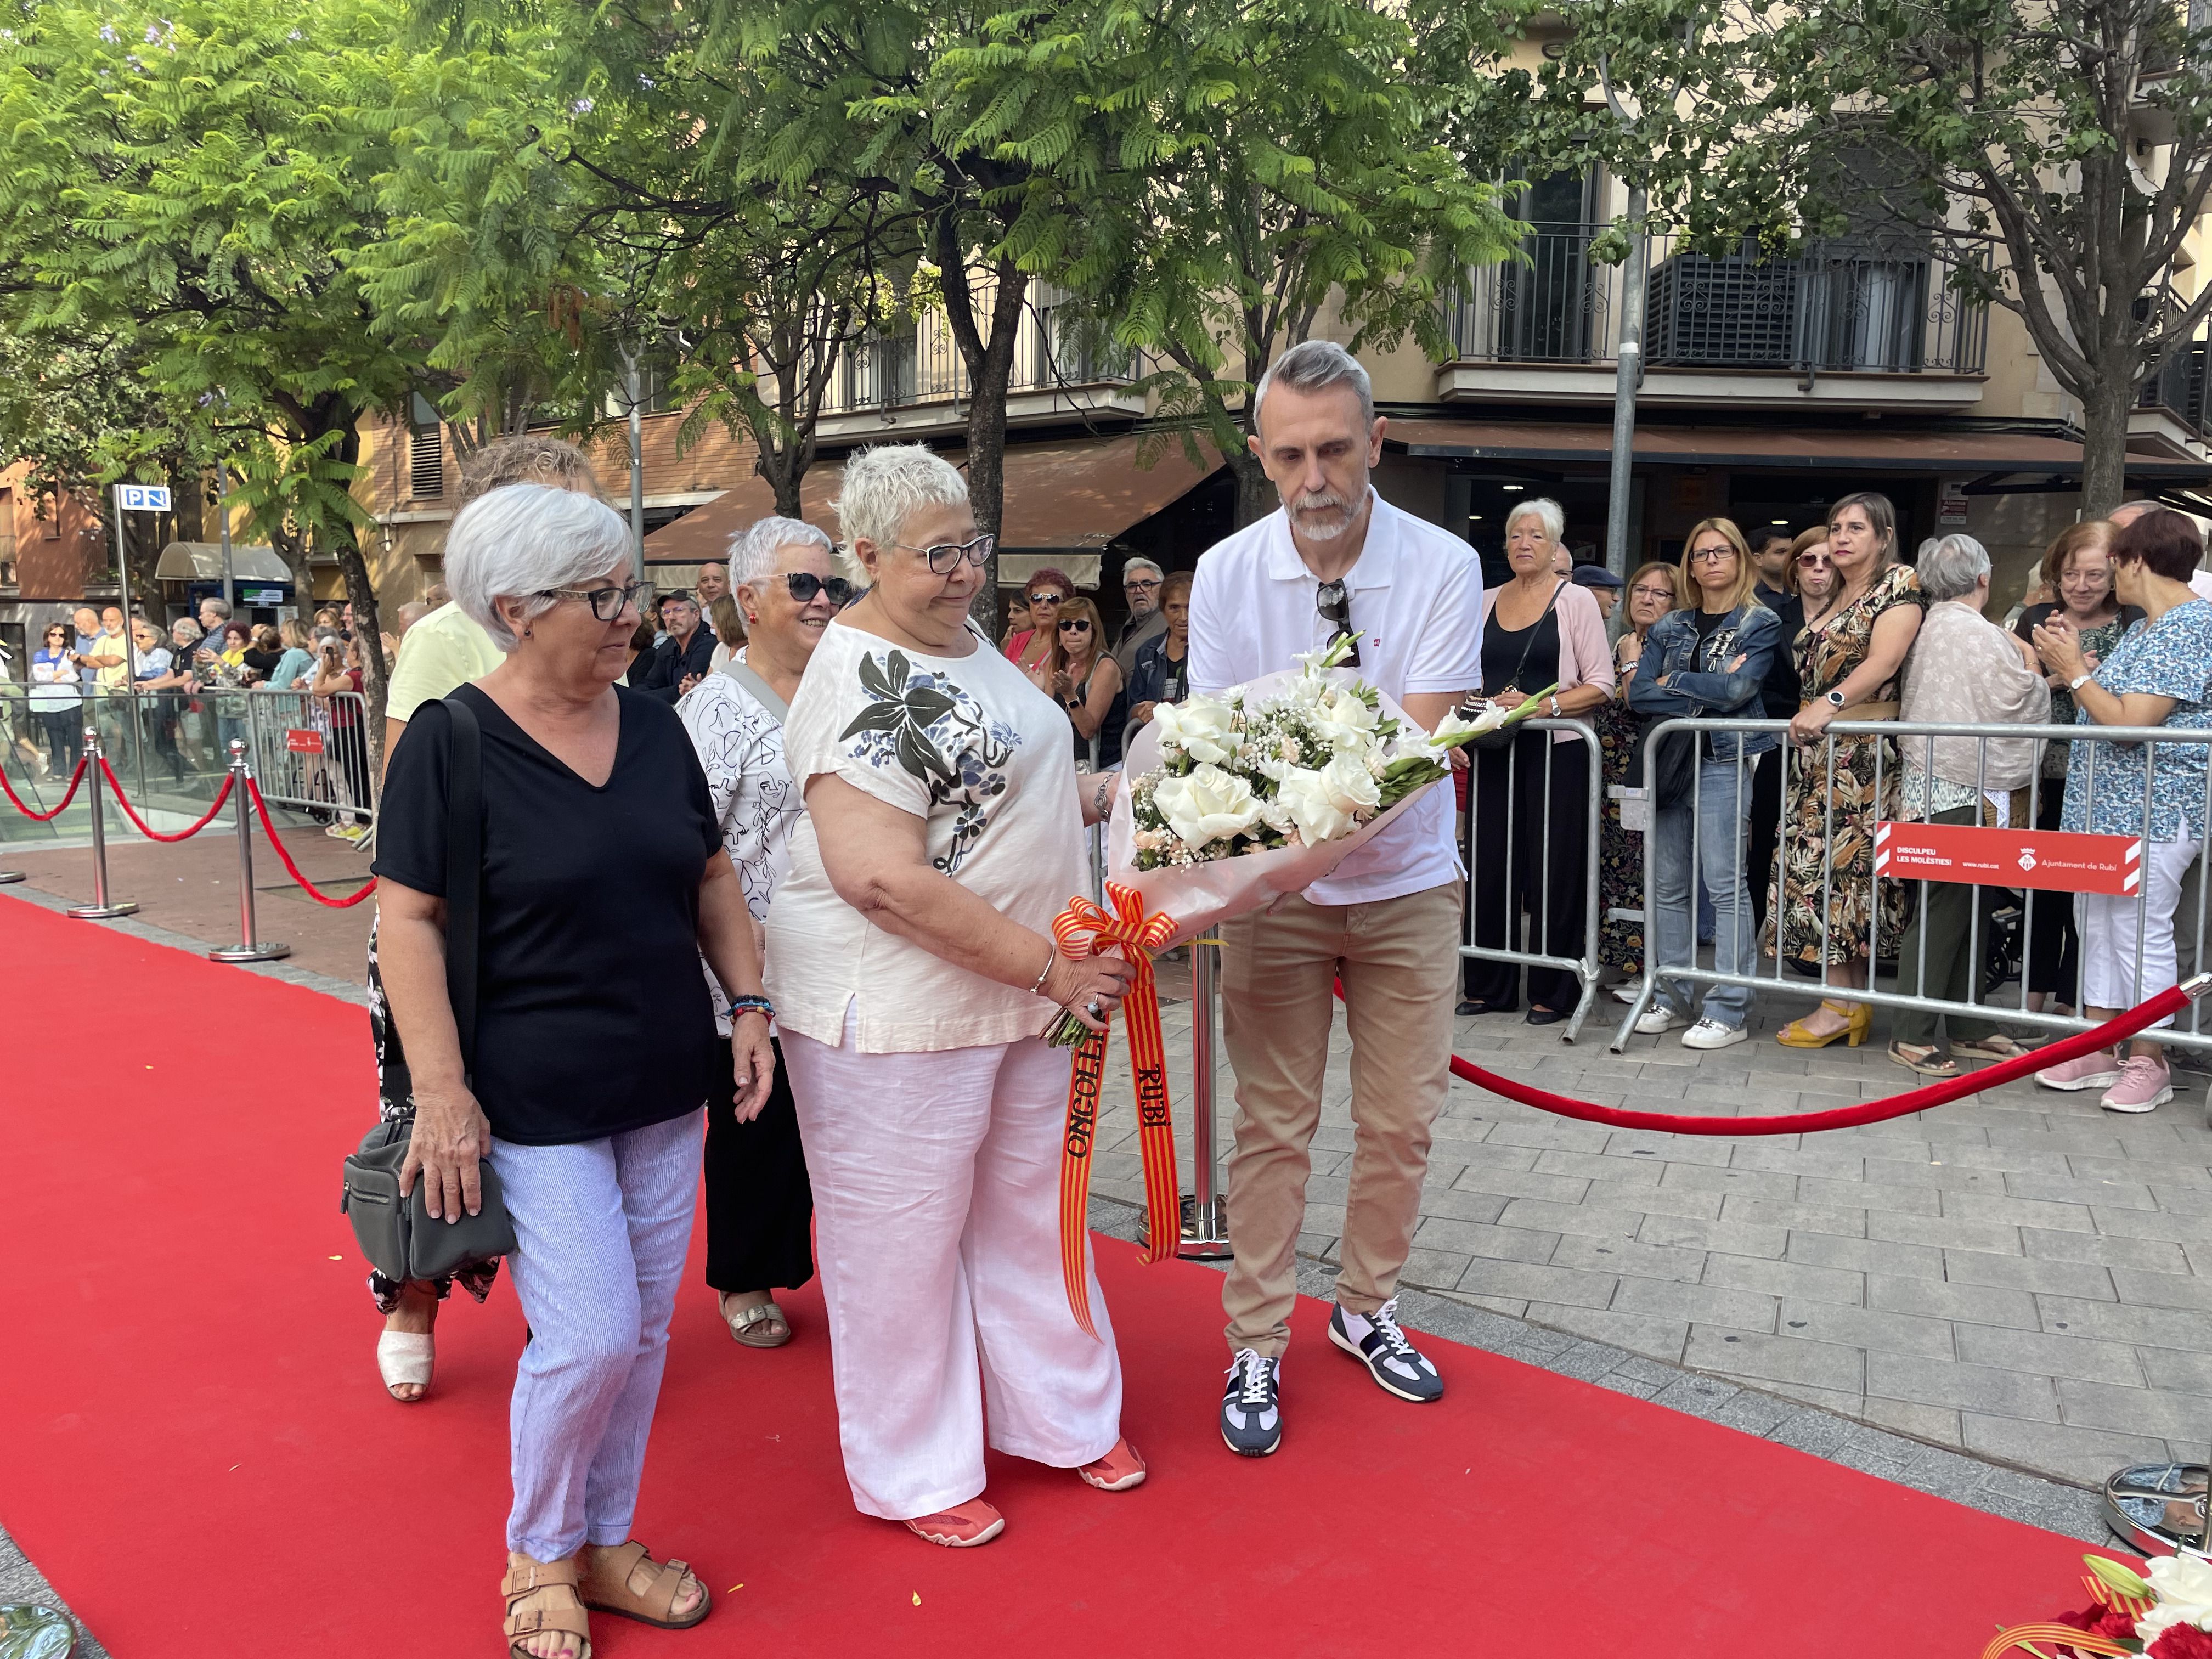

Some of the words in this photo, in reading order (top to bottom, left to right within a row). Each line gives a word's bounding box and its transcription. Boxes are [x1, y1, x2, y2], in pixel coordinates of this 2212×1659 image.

[129, 490, 141, 505] P
[1897, 847, 1936, 855] DISCULPEU
[1911, 856, 1952, 866] MOLÈSTIES!
[2041, 859, 2085, 868] Ajuntament
[2099, 863, 2117, 871] Rubí
